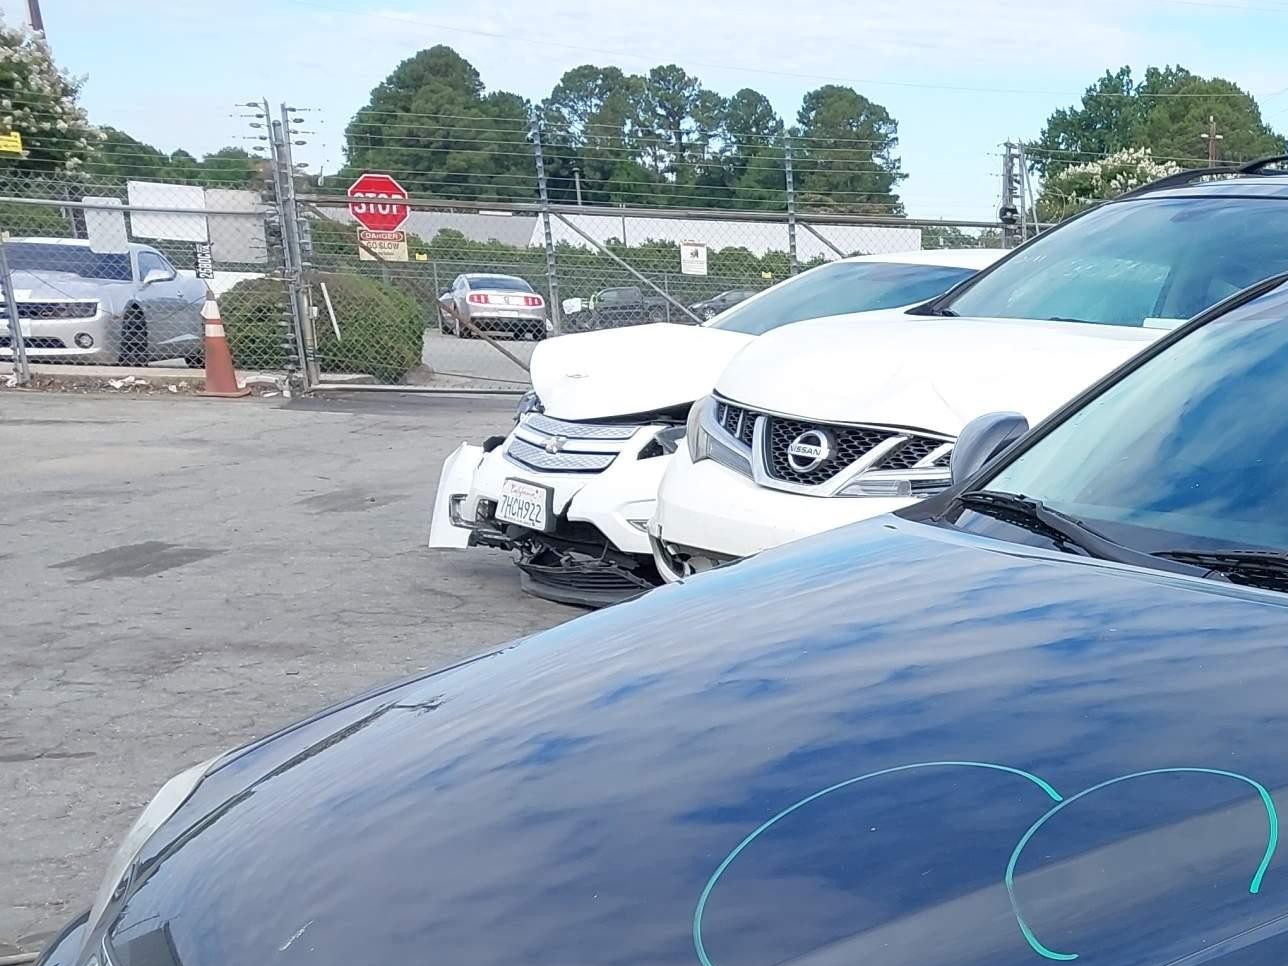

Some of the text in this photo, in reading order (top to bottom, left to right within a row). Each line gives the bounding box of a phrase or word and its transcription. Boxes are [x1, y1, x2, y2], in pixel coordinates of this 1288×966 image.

[353, 192, 403, 215] STOP
[365, 232, 398, 240] DANGER
[379, 241, 399, 250] SLOW
[790, 445, 822, 457] NISSAN
[500, 494, 542, 524] 7HCH922
